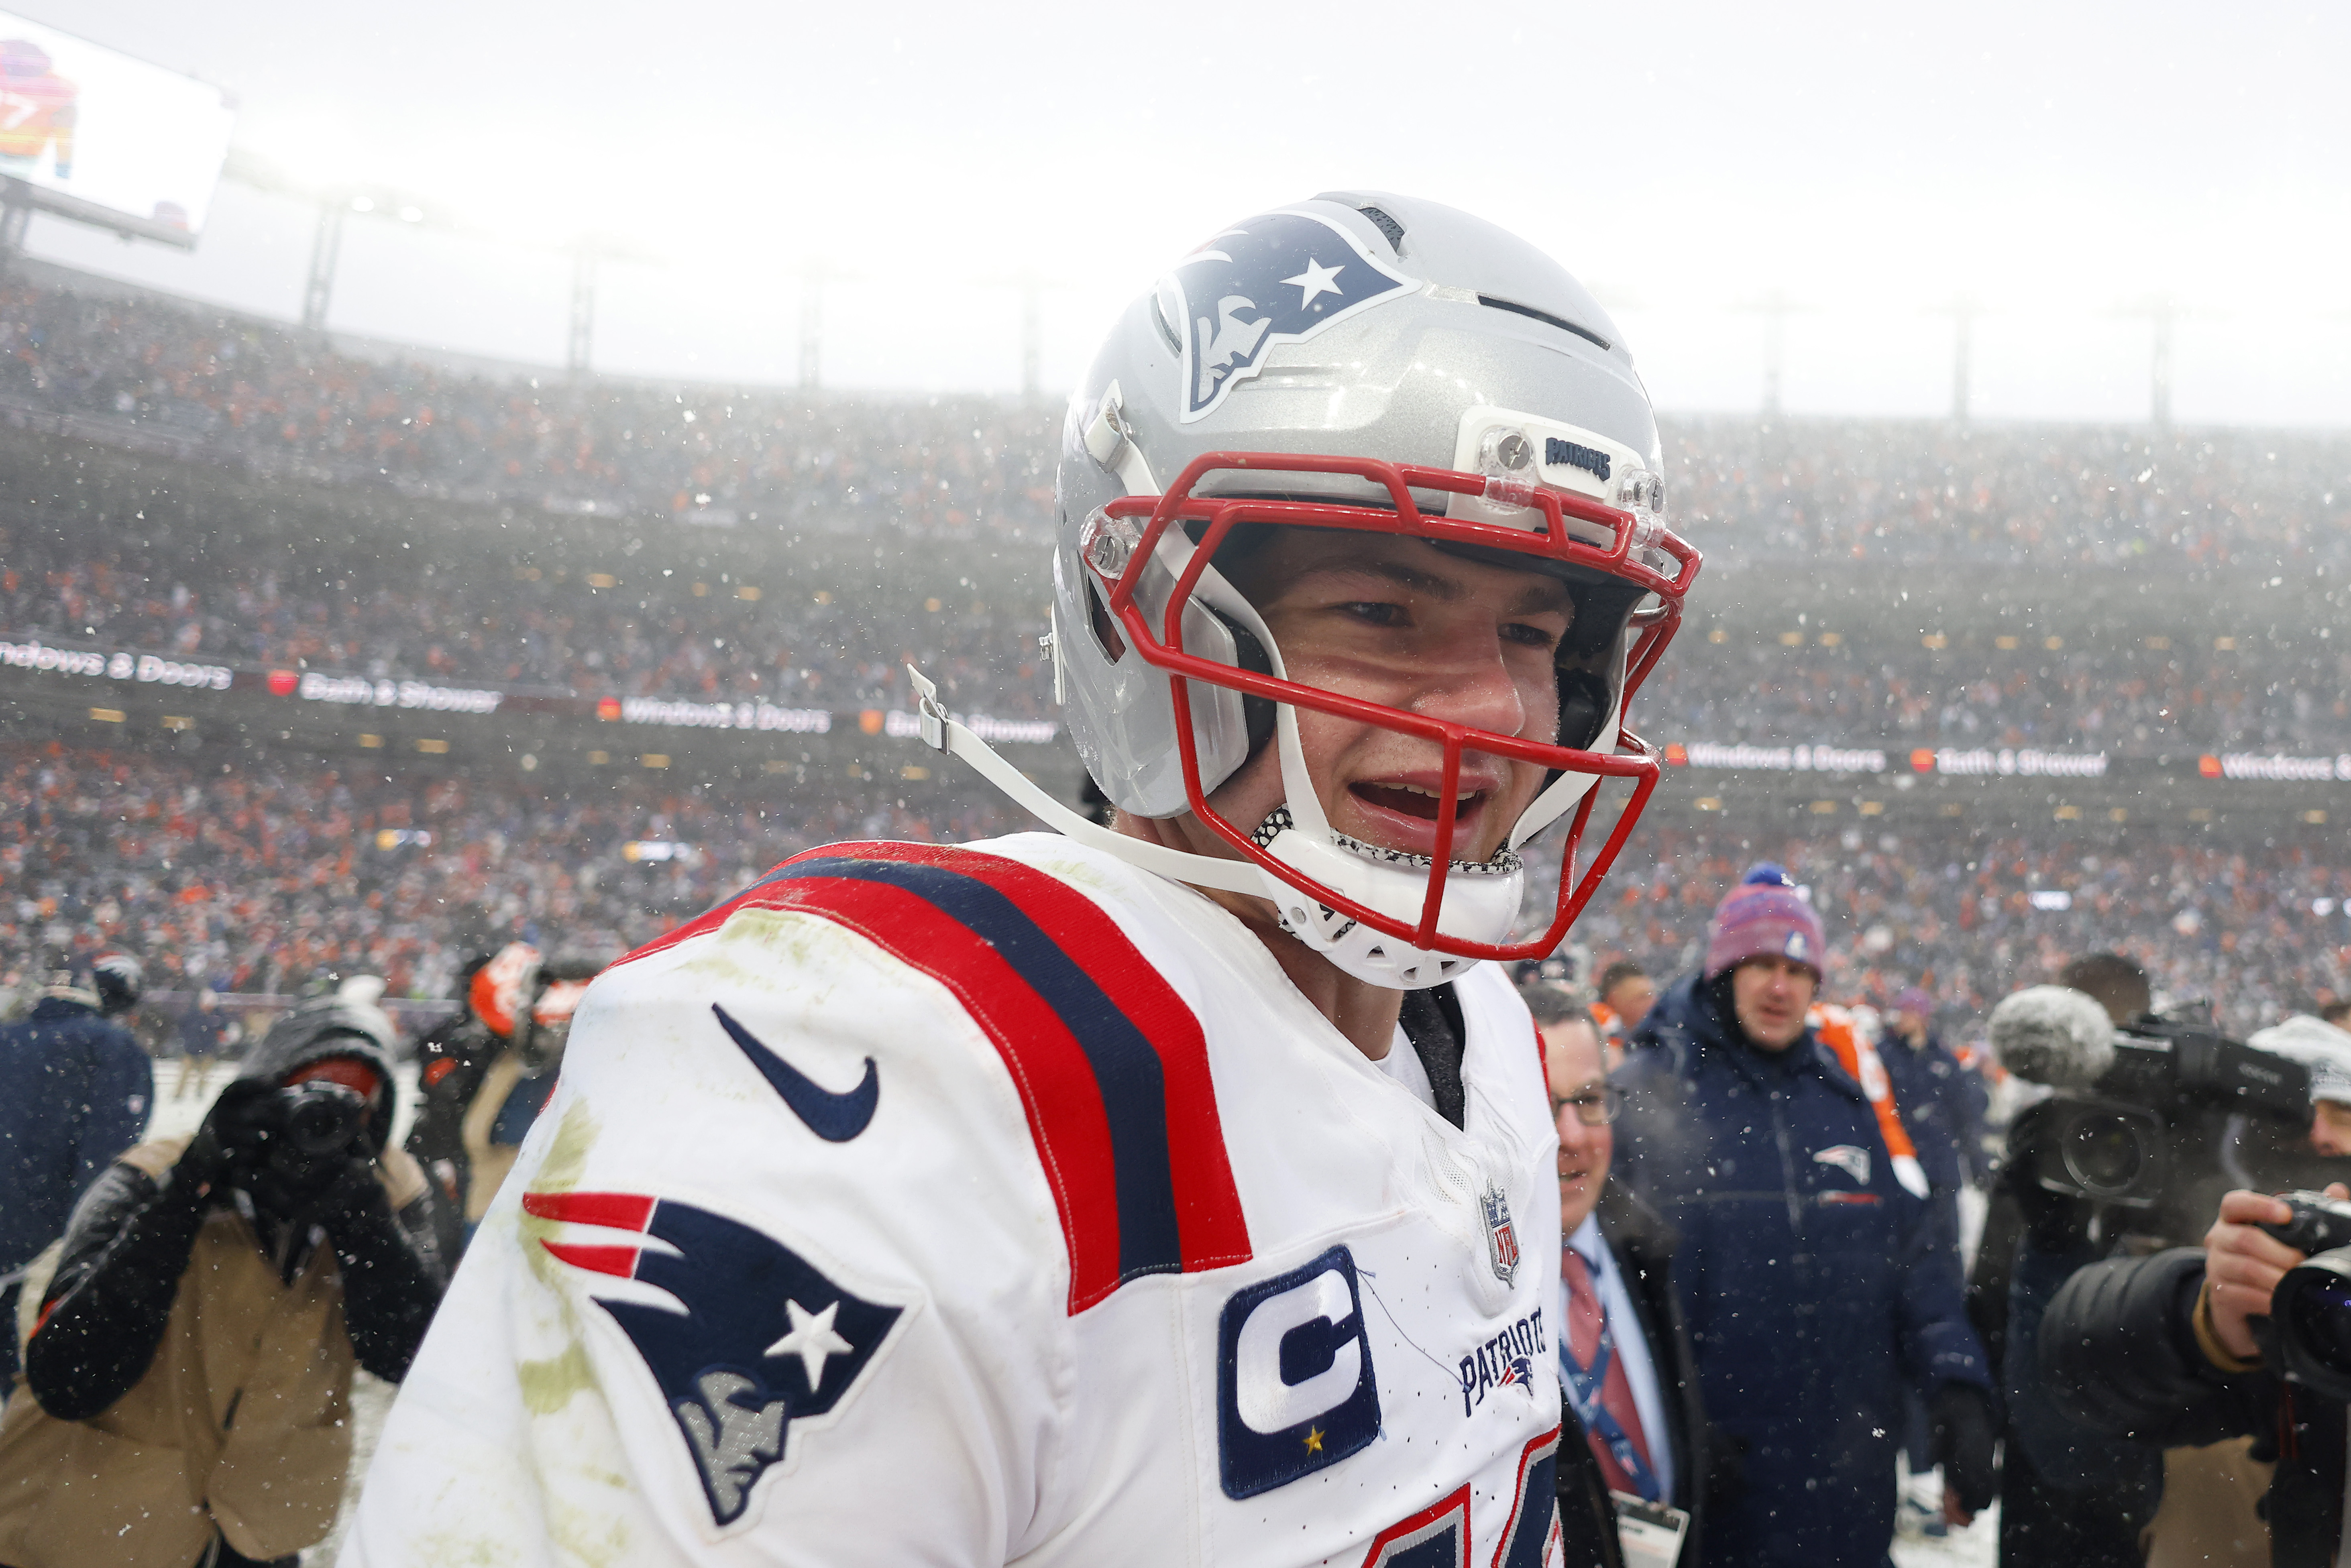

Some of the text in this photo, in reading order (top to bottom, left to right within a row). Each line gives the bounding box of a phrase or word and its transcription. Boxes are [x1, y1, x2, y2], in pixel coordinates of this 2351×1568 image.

[1546, 437, 1611, 481] PATRIOTS
[1494, 1226, 1518, 1267] NFL
[1237, 1269, 1361, 1435] C
